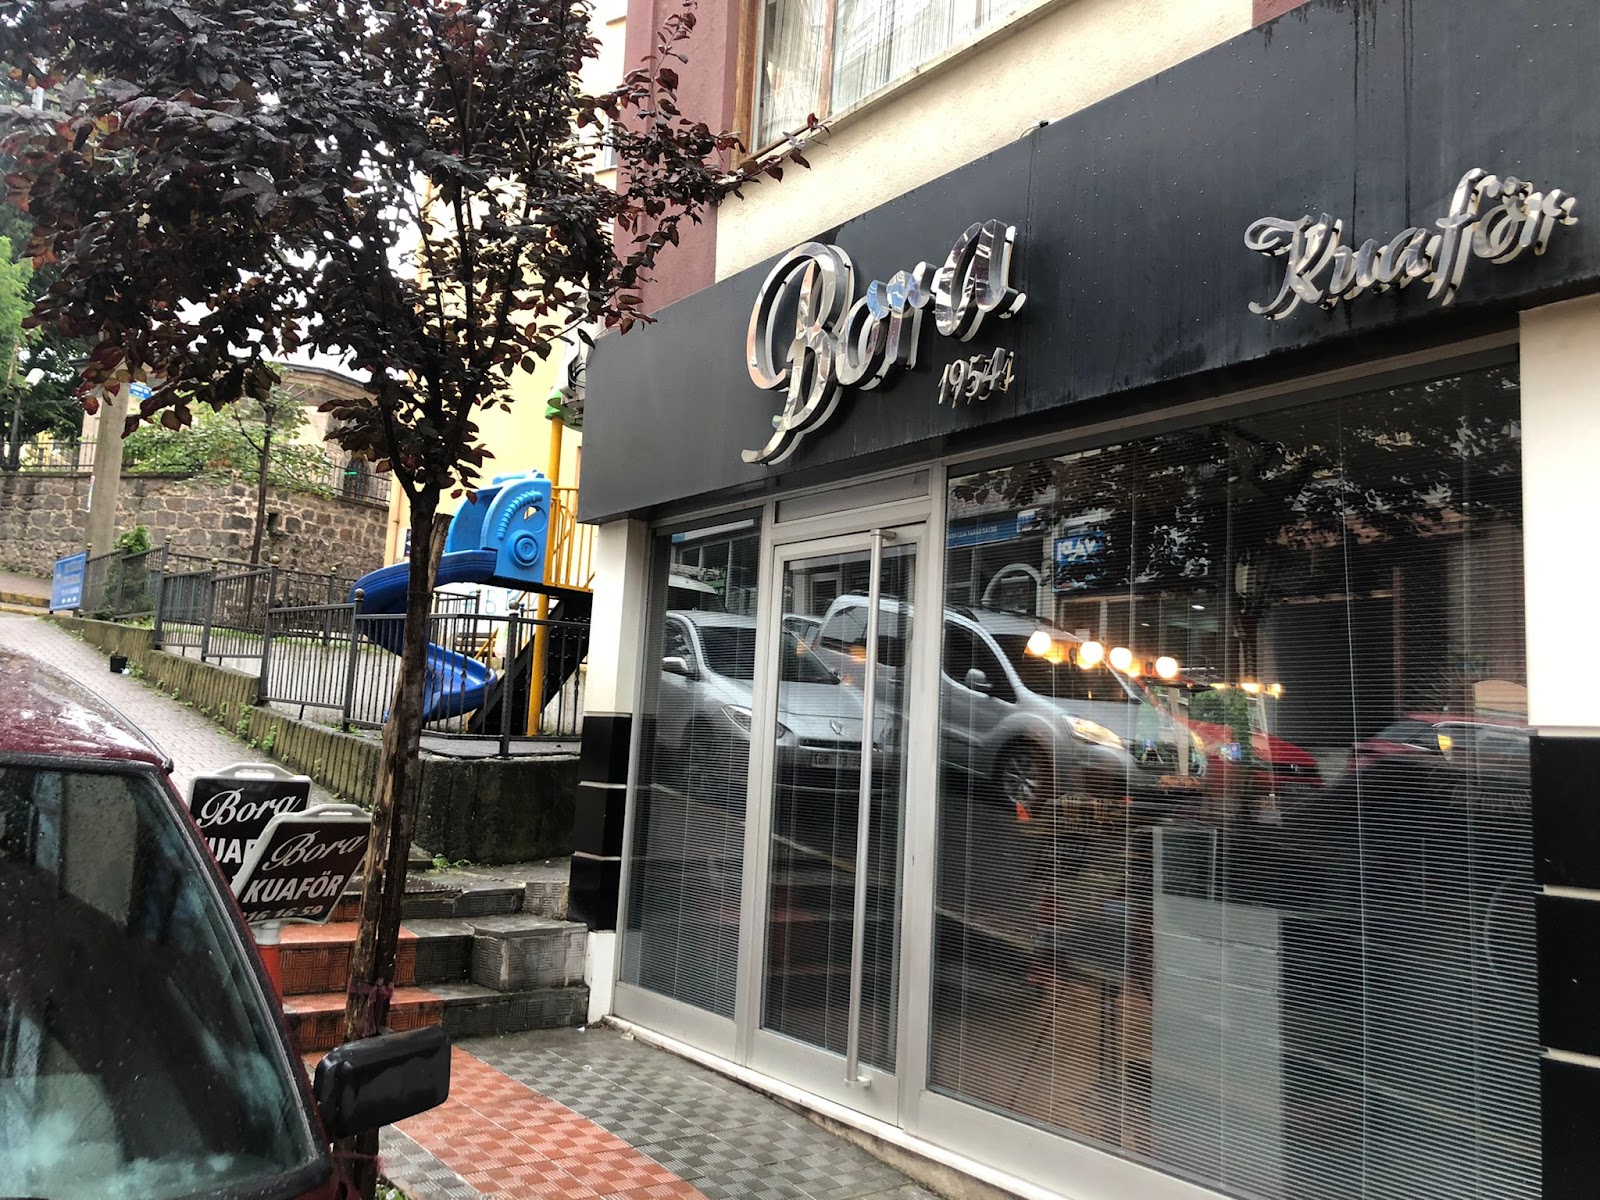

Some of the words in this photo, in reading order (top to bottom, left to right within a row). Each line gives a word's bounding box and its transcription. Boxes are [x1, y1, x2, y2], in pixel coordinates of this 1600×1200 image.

[1244, 166, 1579, 322] Kuaför
[741, 219, 1027, 467] Bora
[195, 787, 301, 829] Bora
[205, 837, 259, 864] UAF
[262, 830, 368, 870] Bora
[241, 870, 345, 904] KUAFÖR
[299, 904, 324, 917] 59
